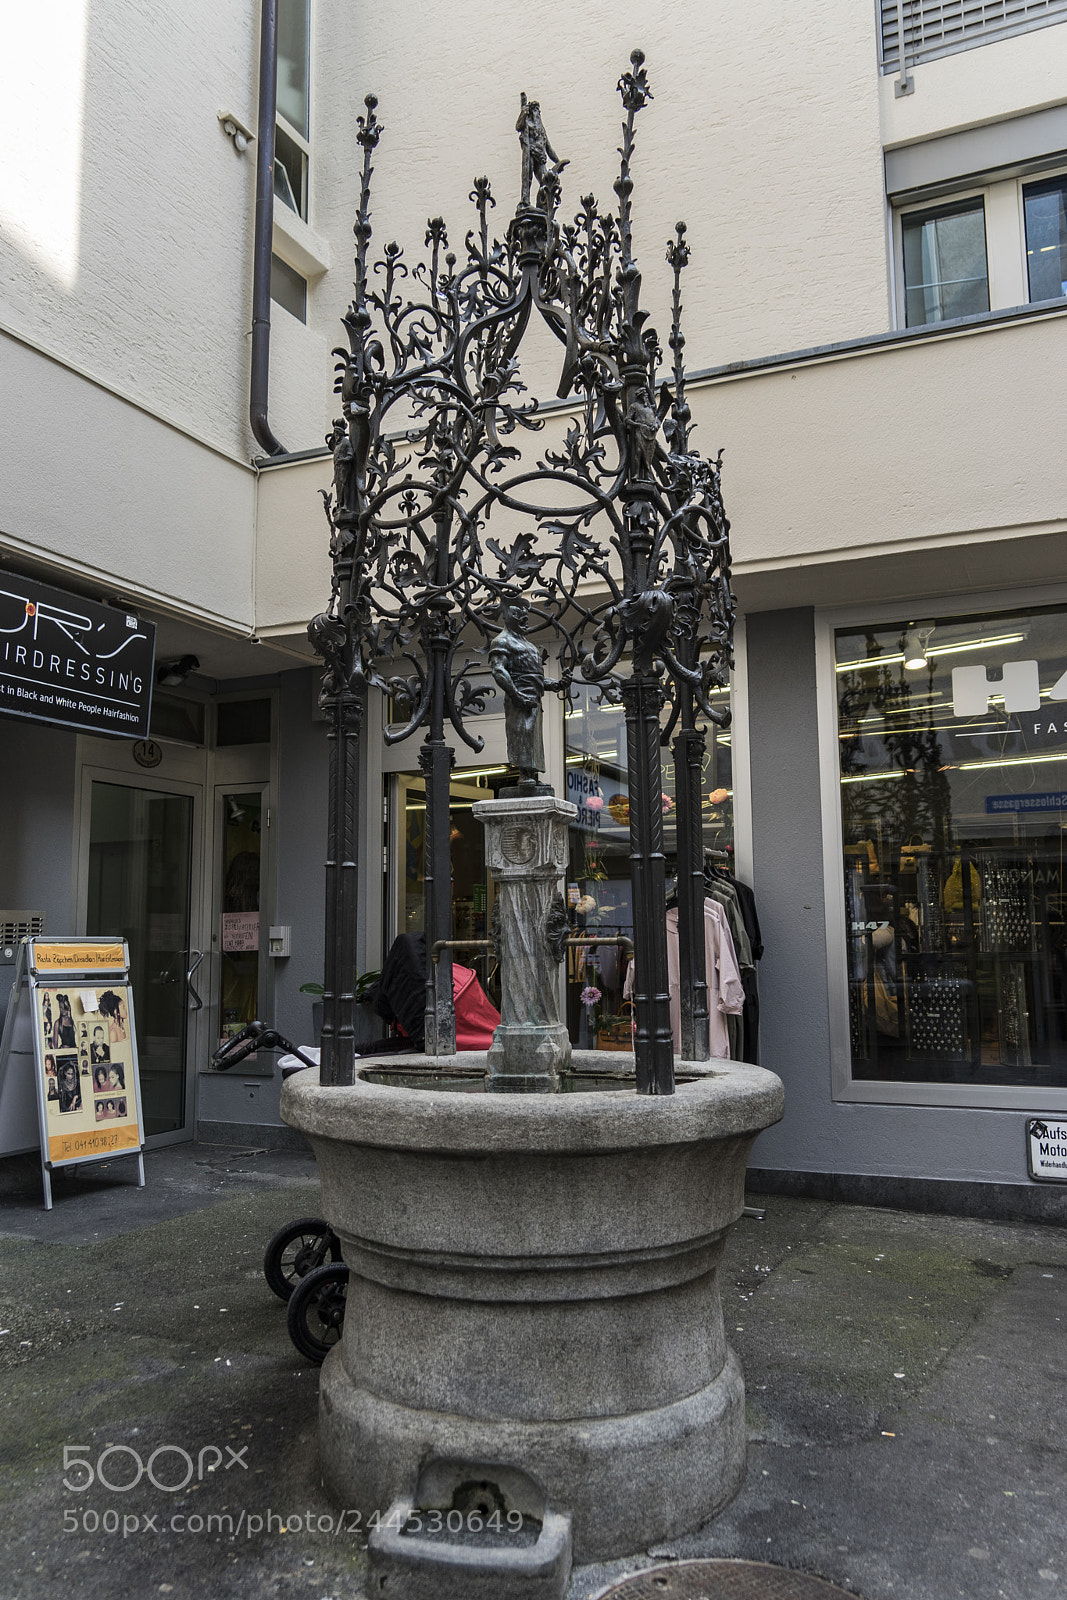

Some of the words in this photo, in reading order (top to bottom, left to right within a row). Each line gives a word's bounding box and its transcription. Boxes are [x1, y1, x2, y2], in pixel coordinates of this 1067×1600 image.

[7, 685, 15, 696] in
[16, 687, 38, 701] Black
[39, 694, 54, 704] and
[55, 695, 77, 710] White
[78, 701, 102, 715] People
[102, 707, 140, 723] Hairfashion
[142, 741, 154, 758] 14
[851, 921, 890, 931] H47
[75, 1140, 87, 1151] 041
